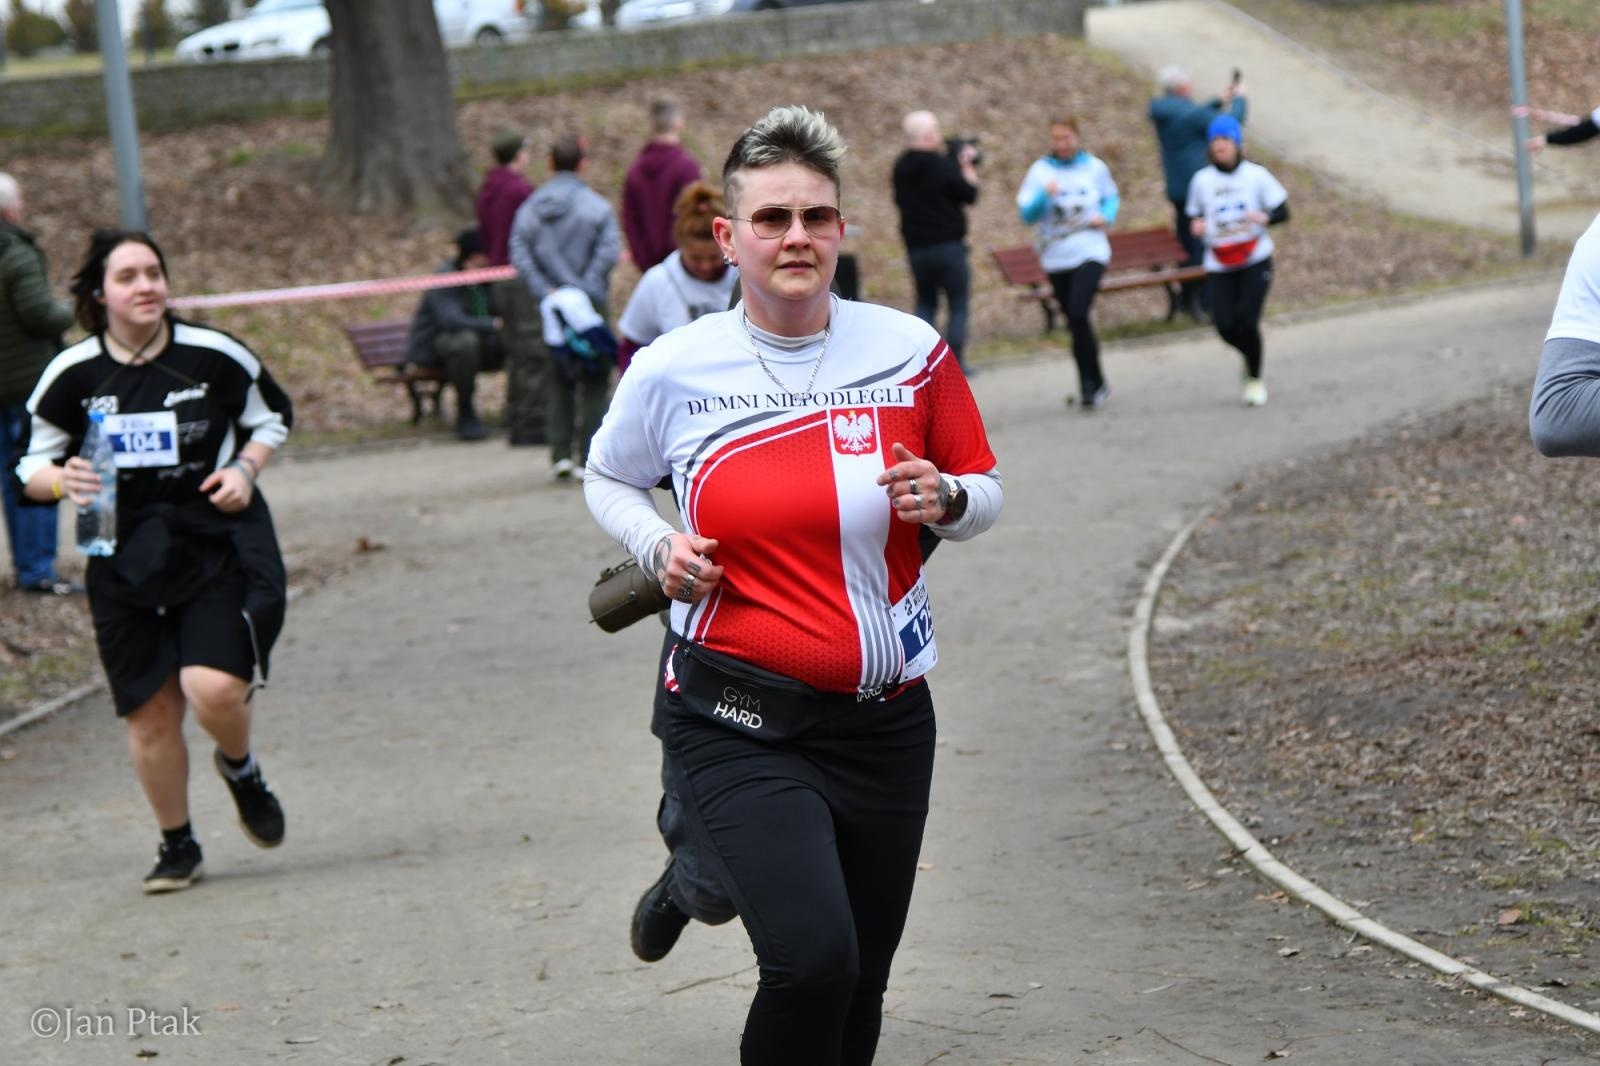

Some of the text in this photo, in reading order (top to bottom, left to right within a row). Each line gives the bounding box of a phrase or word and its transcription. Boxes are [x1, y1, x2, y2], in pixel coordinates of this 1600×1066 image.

[687, 388, 904, 415] DUMNI NIEPODLEGLI
[120, 432, 161, 452] 104
[723, 686, 760, 711] GYM
[713, 701, 762, 728] HARD
